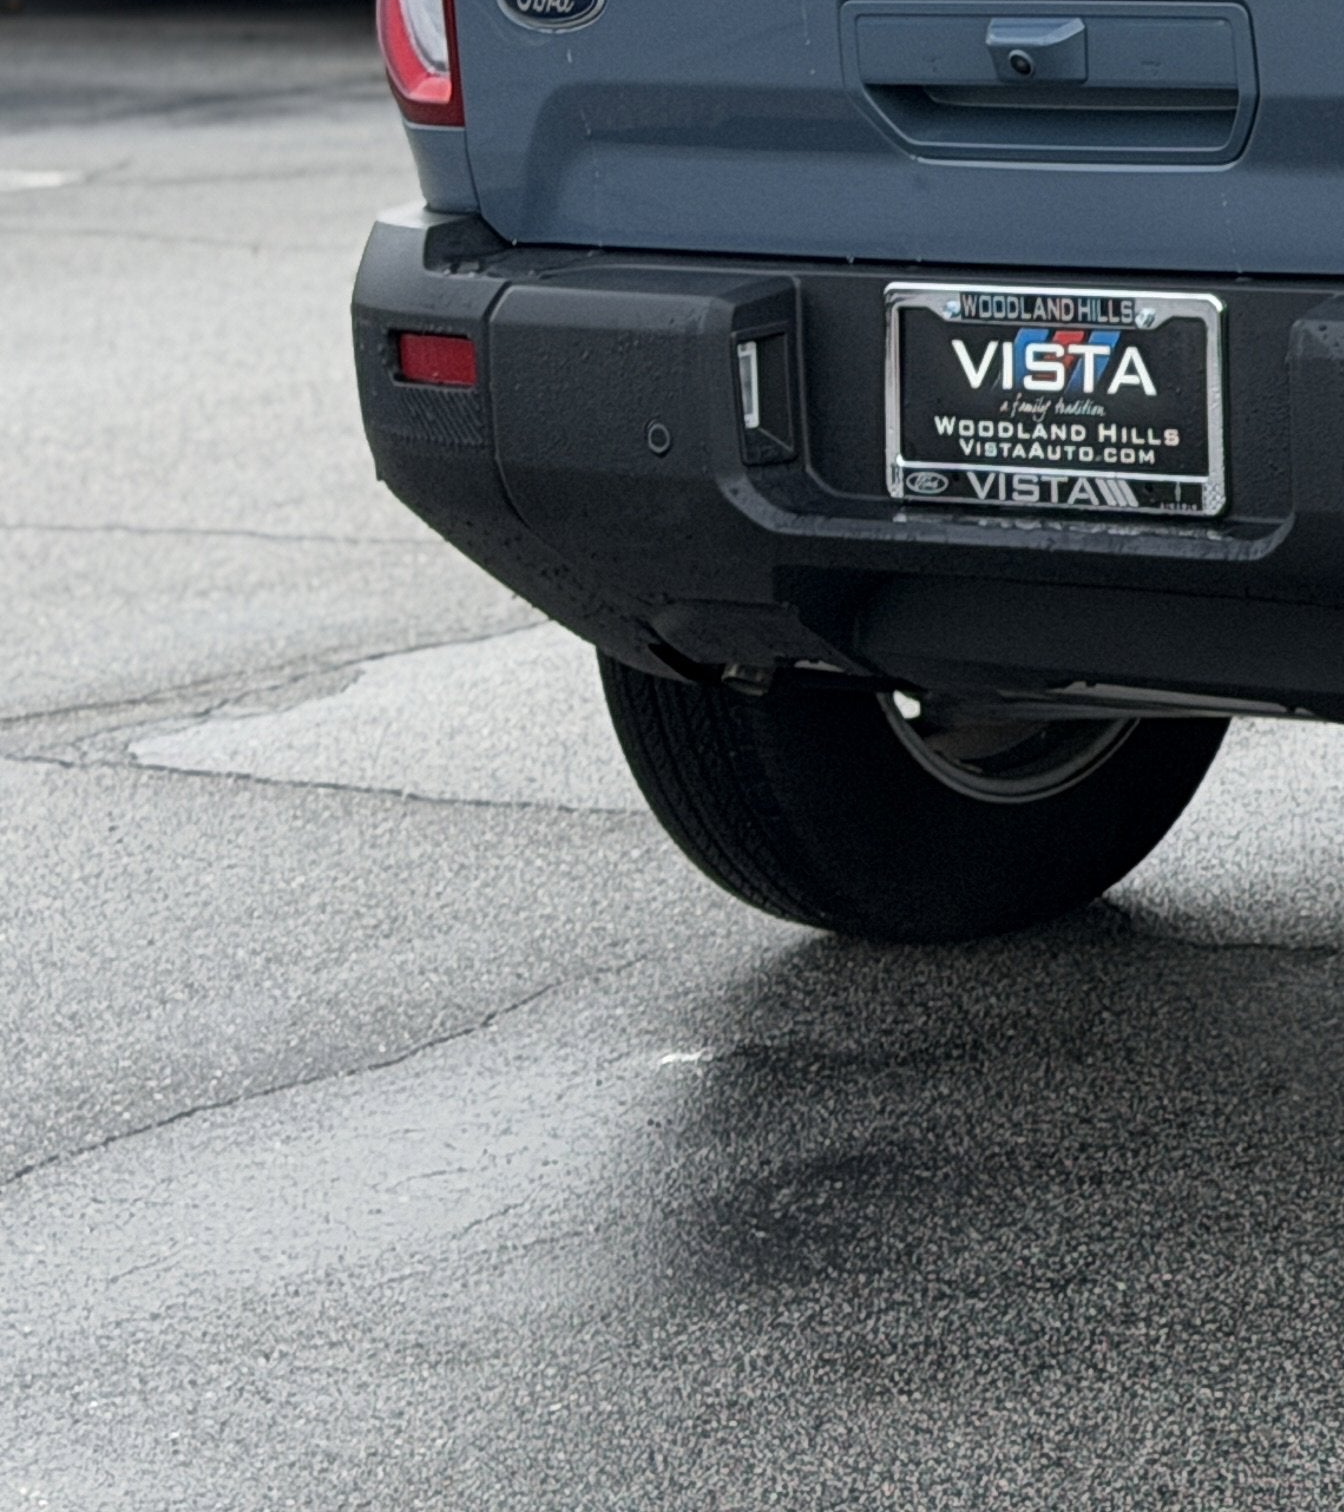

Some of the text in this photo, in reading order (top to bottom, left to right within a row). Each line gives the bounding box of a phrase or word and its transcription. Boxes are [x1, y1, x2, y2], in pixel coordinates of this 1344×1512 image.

[961, 295, 1135, 324] WOODLAND HILLS
[951, 339, 1158, 396] VISTA
[1010, 392, 1052, 423] family
[1055, 397, 1107, 418] tradition
[966, 471, 1103, 507] VISTA
